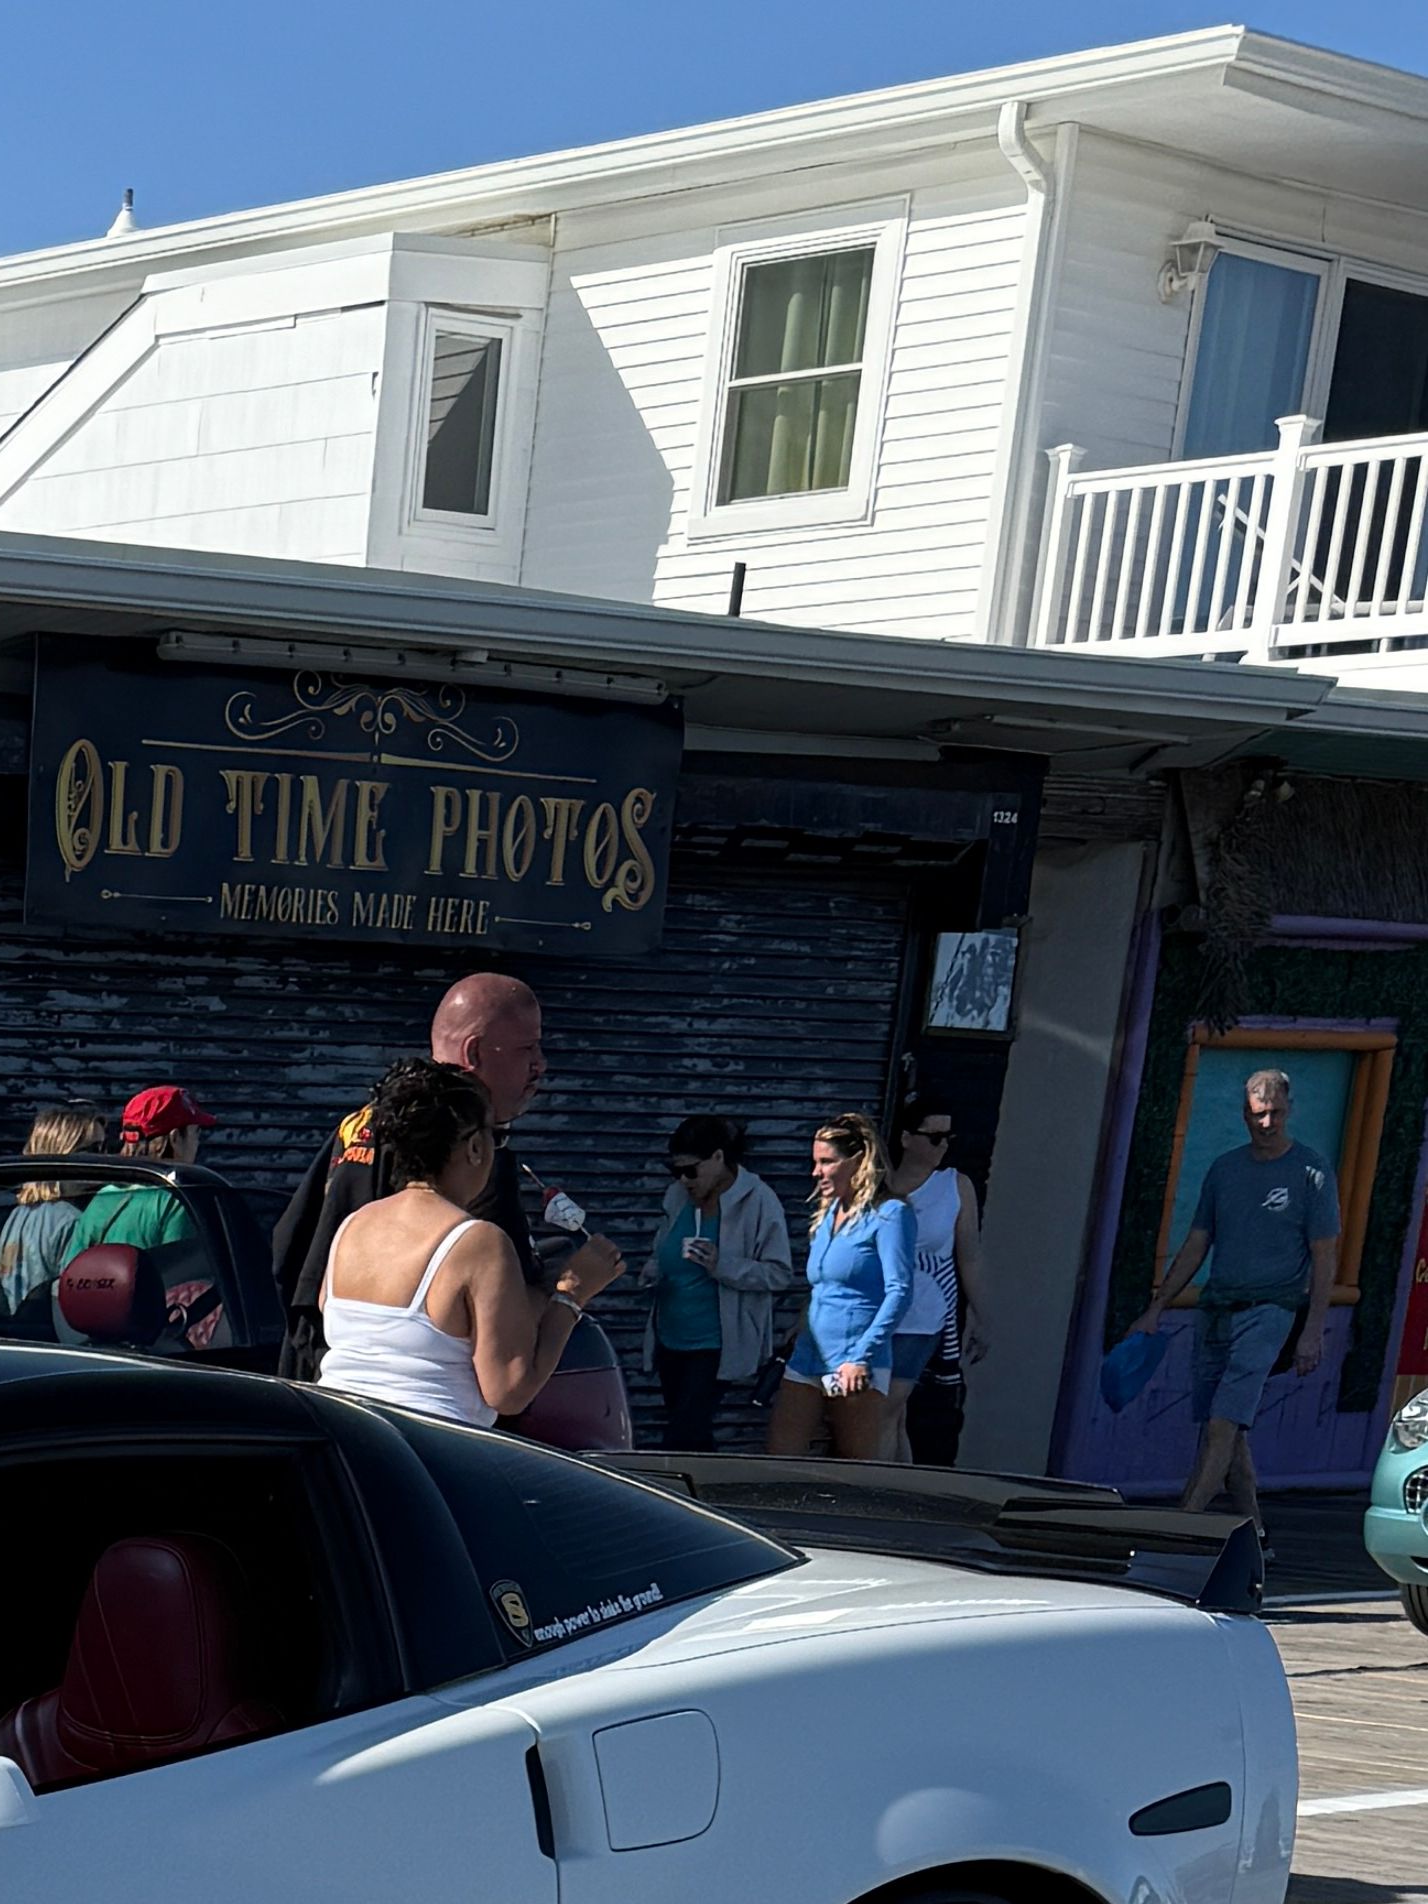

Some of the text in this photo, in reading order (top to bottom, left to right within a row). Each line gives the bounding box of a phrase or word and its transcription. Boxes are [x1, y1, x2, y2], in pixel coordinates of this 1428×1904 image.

[220, 770, 391, 872] TIME
[220, 882, 490, 934] MEMORIES MADE HERE
